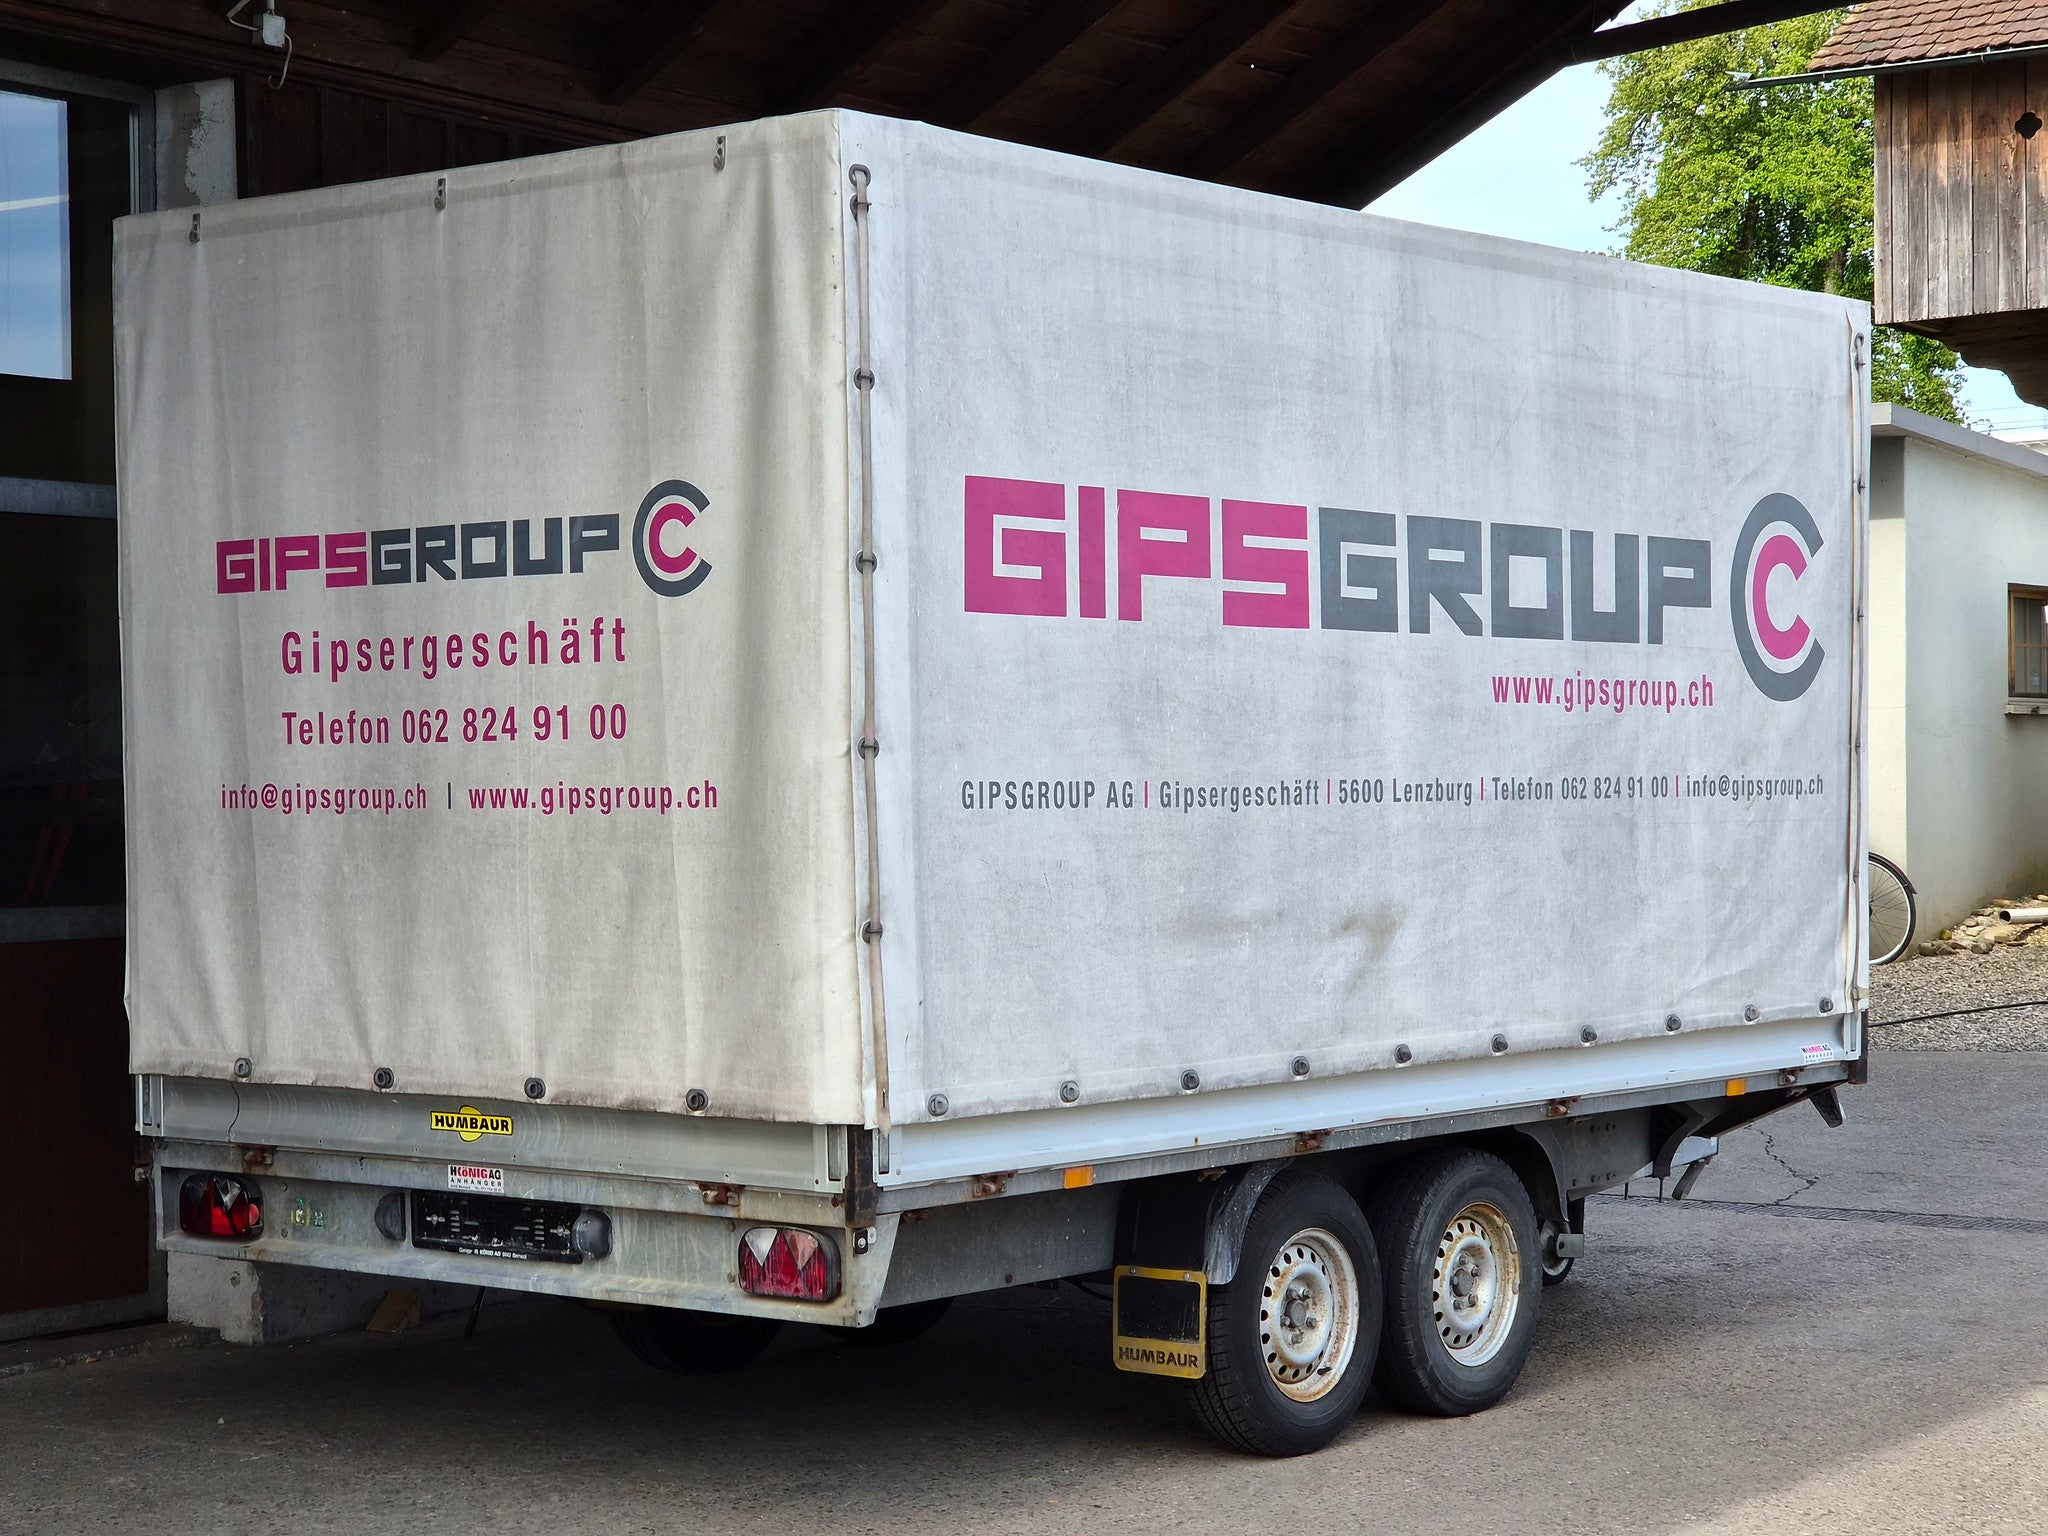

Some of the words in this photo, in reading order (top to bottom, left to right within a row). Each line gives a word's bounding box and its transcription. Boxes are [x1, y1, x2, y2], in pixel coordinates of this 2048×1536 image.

[216, 513, 620, 595] GIPSGROUP
[963, 474, 1712, 645] GIPSGROUP
[281, 616, 627, 683] Gipsergeschäft
[1492, 672, 1714, 713] www.gipsgroup.ch
[281, 711, 390, 746] Telefon
[401, 708, 449, 744] 062
[462, 706, 519, 743] 824
[532, 704, 570, 742] 91
[589, 703, 628, 741] 00
[220, 783, 428, 815] info@gipsgroup.ch
[468, 779, 719, 816] www.gipsgroup.ch
[960, 780, 1096, 811] GIPSGROUP
[1106, 780, 1135, 809] AG
[1159, 779, 1320, 813] Gipsergeschäft
[1338, 777, 1384, 804] 5600
[1392, 777, 1473, 806] Lenzburg
[1491, 775, 1553, 802] Telefon
[1561, 776, 1588, 800] 062
[1593, 776, 1622, 800] 824
[1628, 775, 1643, 799] 91
[1651, 774, 1669, 799] 00
[1686, 773, 1824, 801] info@gipsgroup.ch
[435, 1114, 509, 1132] HUMBAUR
[1118, 1346, 1198, 1369] HUMBAUR
